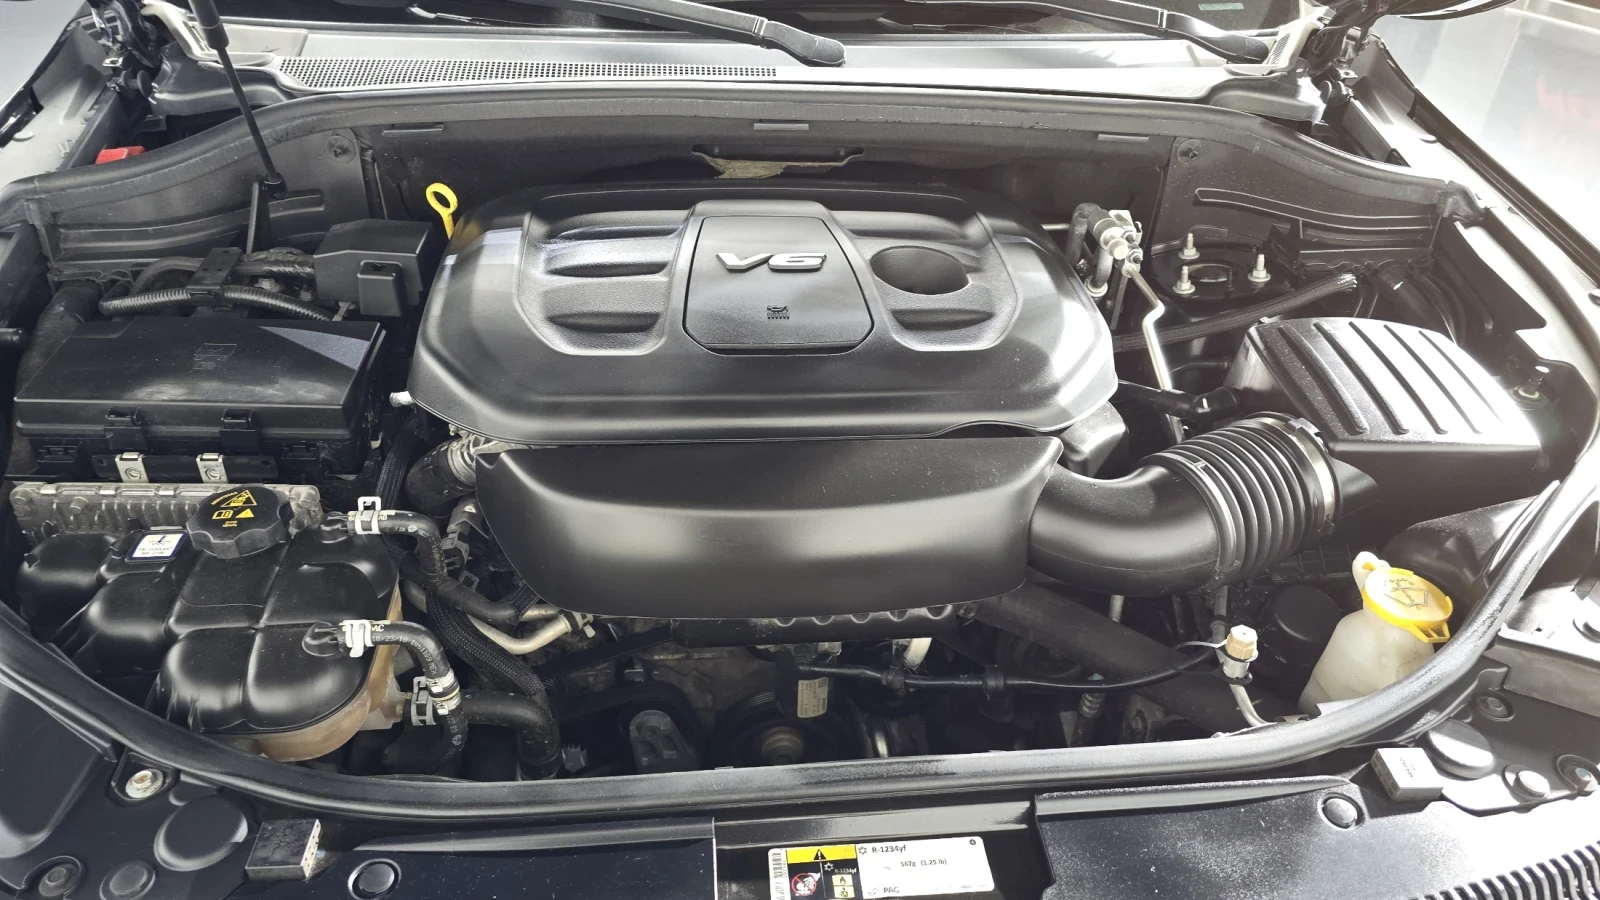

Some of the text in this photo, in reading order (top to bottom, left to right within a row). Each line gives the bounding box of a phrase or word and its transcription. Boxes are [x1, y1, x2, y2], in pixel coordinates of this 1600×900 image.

[715, 252, 827, 273] V6
[871, 844, 906, 854] R-1234yf
[900, 860, 917, 868] 567g
[920, 859, 938, 867] (1.25
[883, 886, 900, 894] PAG
